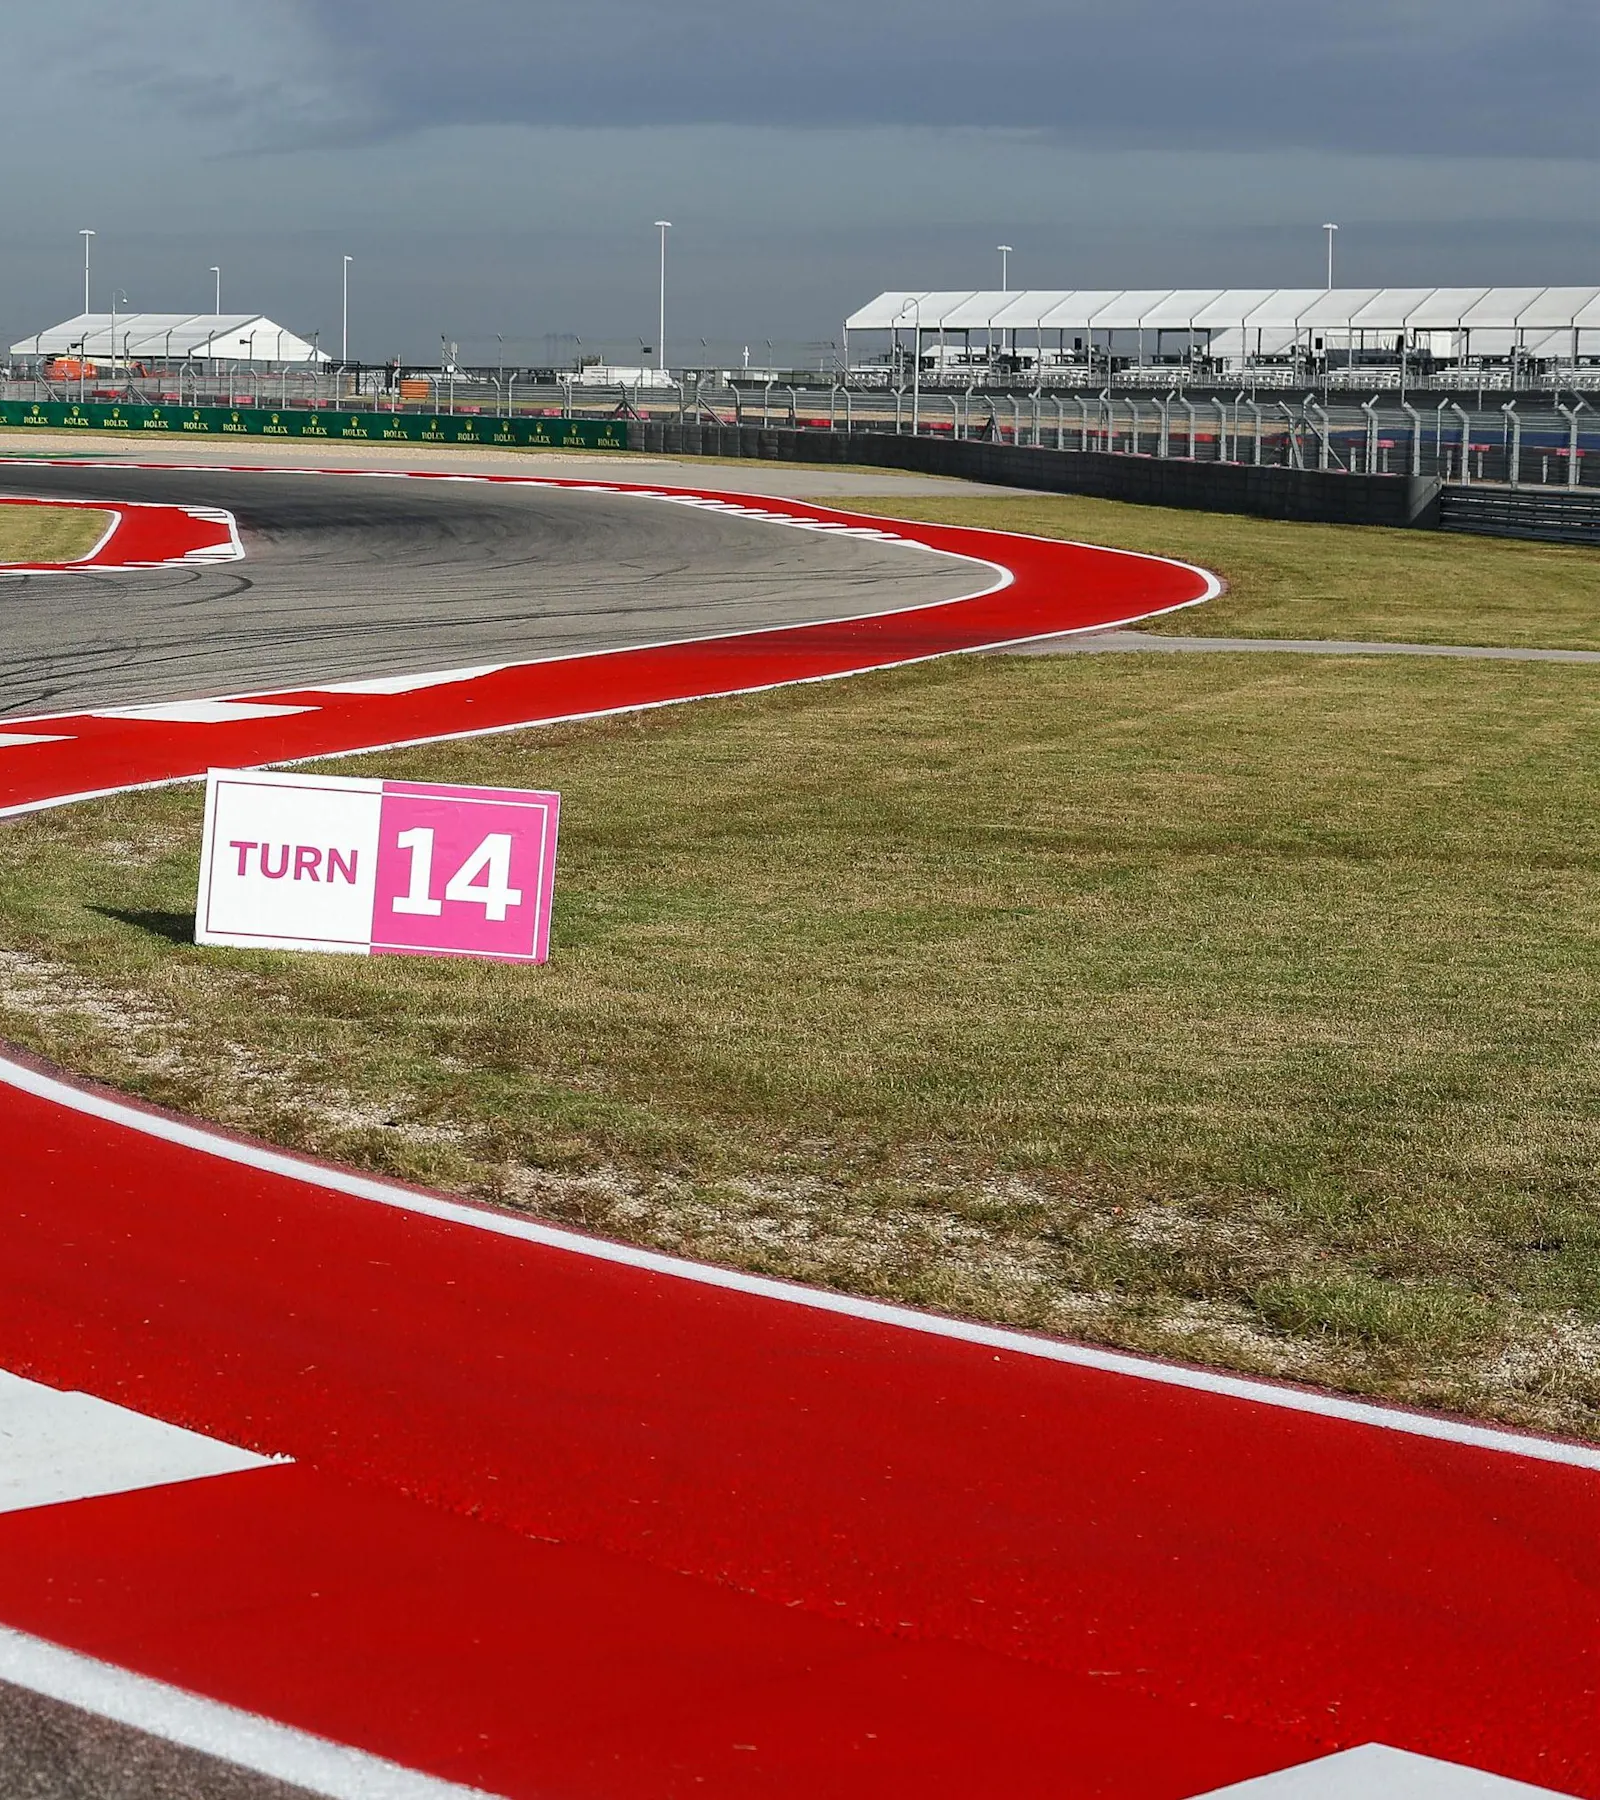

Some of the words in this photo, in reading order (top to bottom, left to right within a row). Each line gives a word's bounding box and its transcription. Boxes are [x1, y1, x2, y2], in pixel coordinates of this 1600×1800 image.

[24, 416, 48, 424] ROLEX
[64, 418, 88, 426] ROLEX
[104, 419, 128, 427] ROLEX
[144, 420, 168, 428] ROLEX
[183, 422, 208, 430] ROLEX
[223, 423, 248, 432] ROLEX
[263, 425, 288, 434] ROLEX
[302, 426, 327, 435] ROLEX
[342, 429, 367, 437] ROLEX
[383, 430, 408, 439] ROLEX
[421, 432, 444, 440] ROLEX
[457, 432, 480, 441] ROLEX
[494, 434, 516, 442] ROLEX
[529, 435, 550, 444] ROLEX
[563, 437, 586, 446] ROLEX
[598, 438, 620, 447] ROLEX
[229, 840, 358, 884] TURN
[391, 827, 522, 921] 14
